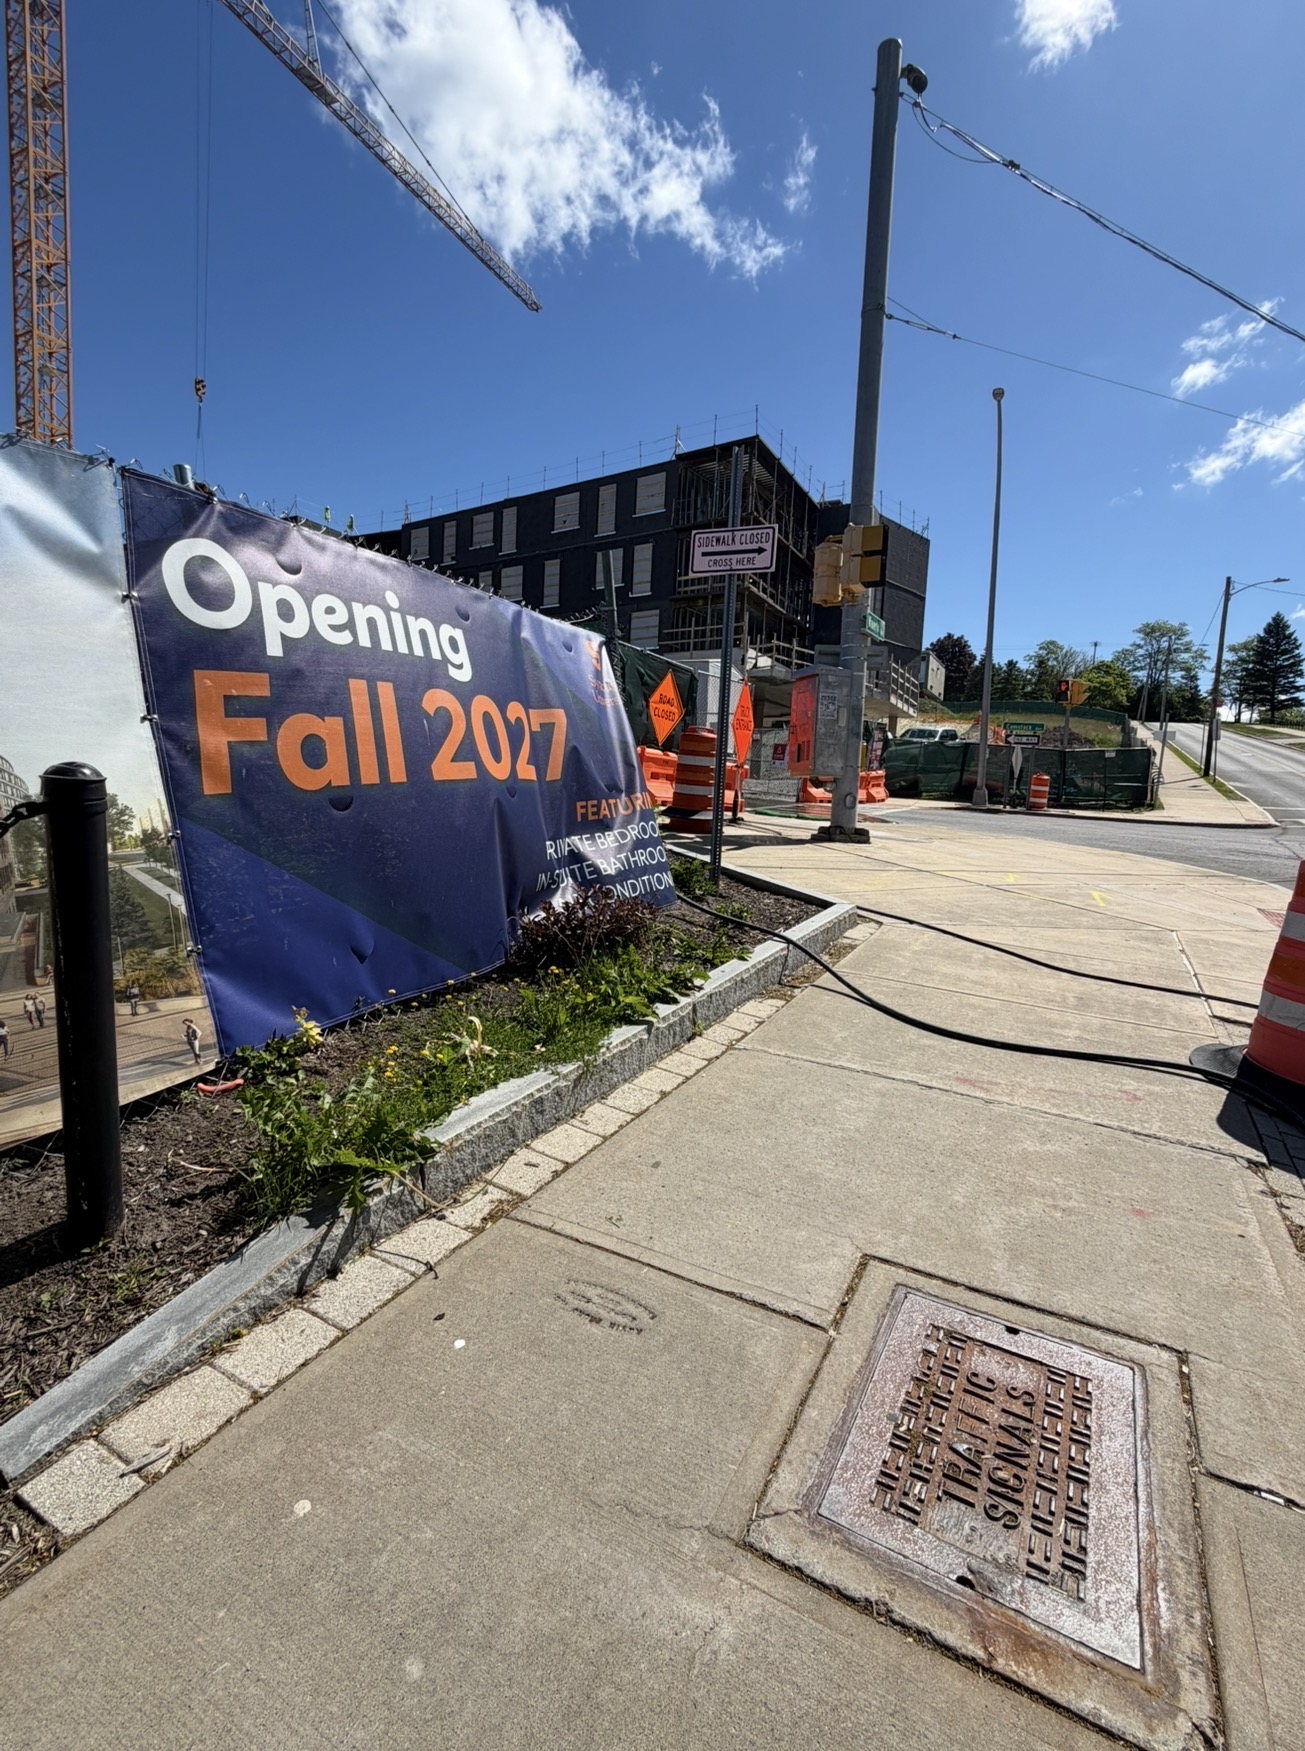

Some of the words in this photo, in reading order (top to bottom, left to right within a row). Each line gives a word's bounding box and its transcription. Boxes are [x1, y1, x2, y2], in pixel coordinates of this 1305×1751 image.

[697, 531, 737, 548] SIDEWALK
[739, 531, 771, 546] CLOSED
[707, 557, 733, 568] CROSS
[735, 556, 757, 566] HERE
[161, 537, 473, 682] Opening
[193, 669, 408, 796] Fall
[421, 688, 568, 782] 2027
[653, 706, 676, 722] CLOSED
[658, 693, 675, 708] ROAD
[937, 1371, 997, 1509] TRAFFIC
[983, 1385, 1036, 1531] SIGNALS
